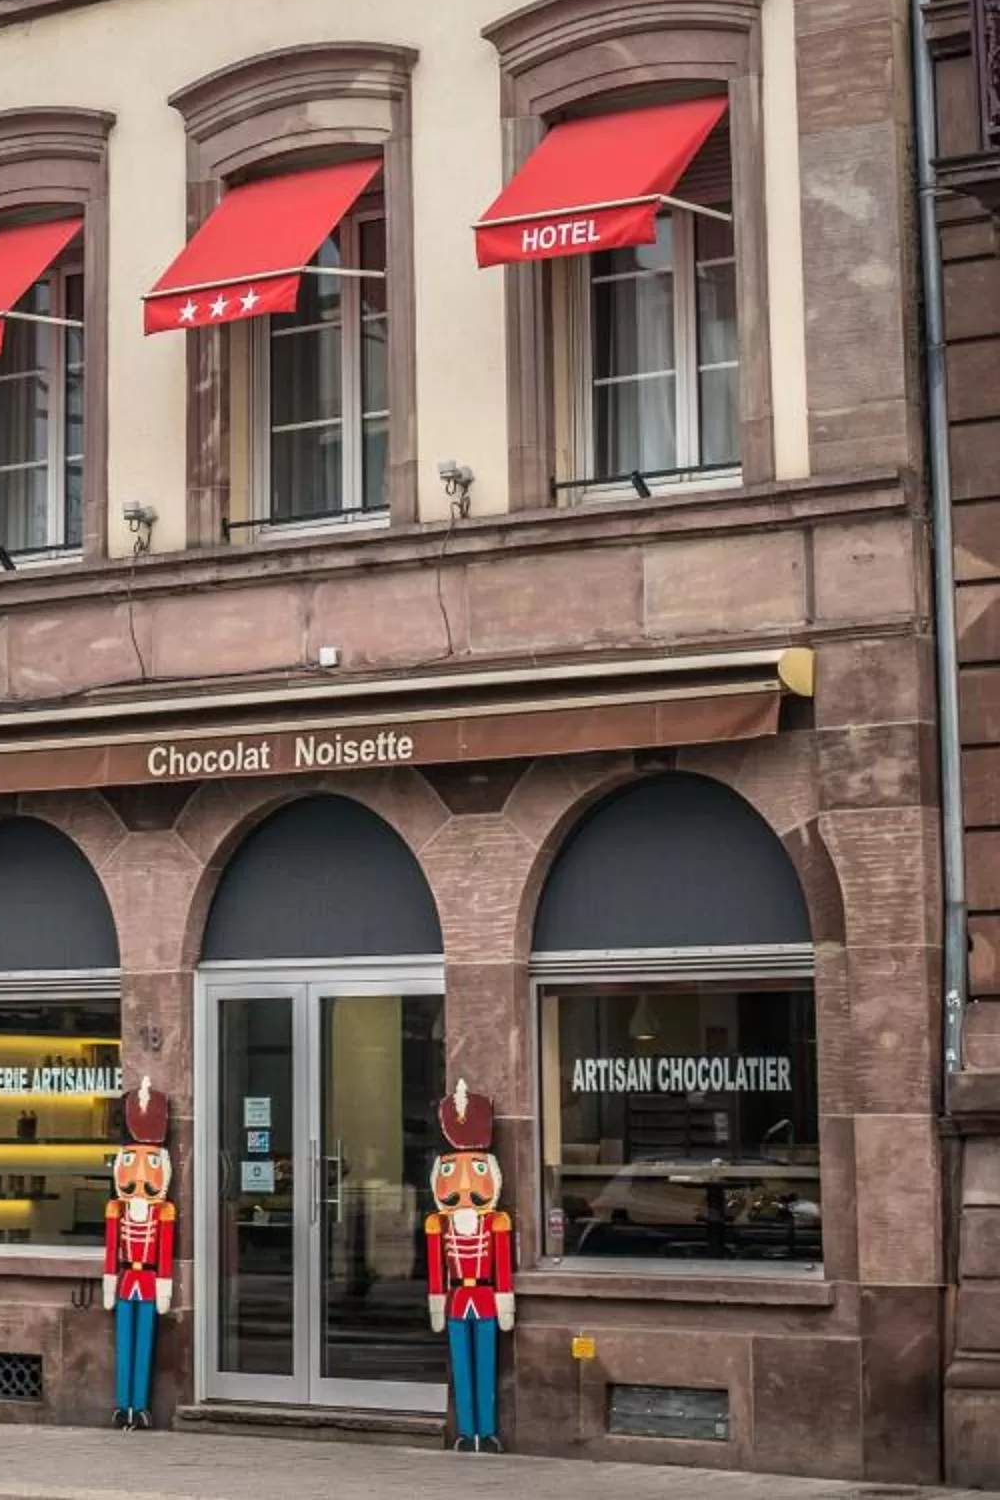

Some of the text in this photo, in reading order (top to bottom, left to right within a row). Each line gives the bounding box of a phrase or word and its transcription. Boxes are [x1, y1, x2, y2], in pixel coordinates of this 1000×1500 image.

[521, 219, 601, 253] HOTEL
[147, 731, 414, 776] Chocolat Noisette
[31, 1067, 122, 1098] ARTISANALE
[571, 1056, 793, 1092] ARTISAN CHOCOLATIER
